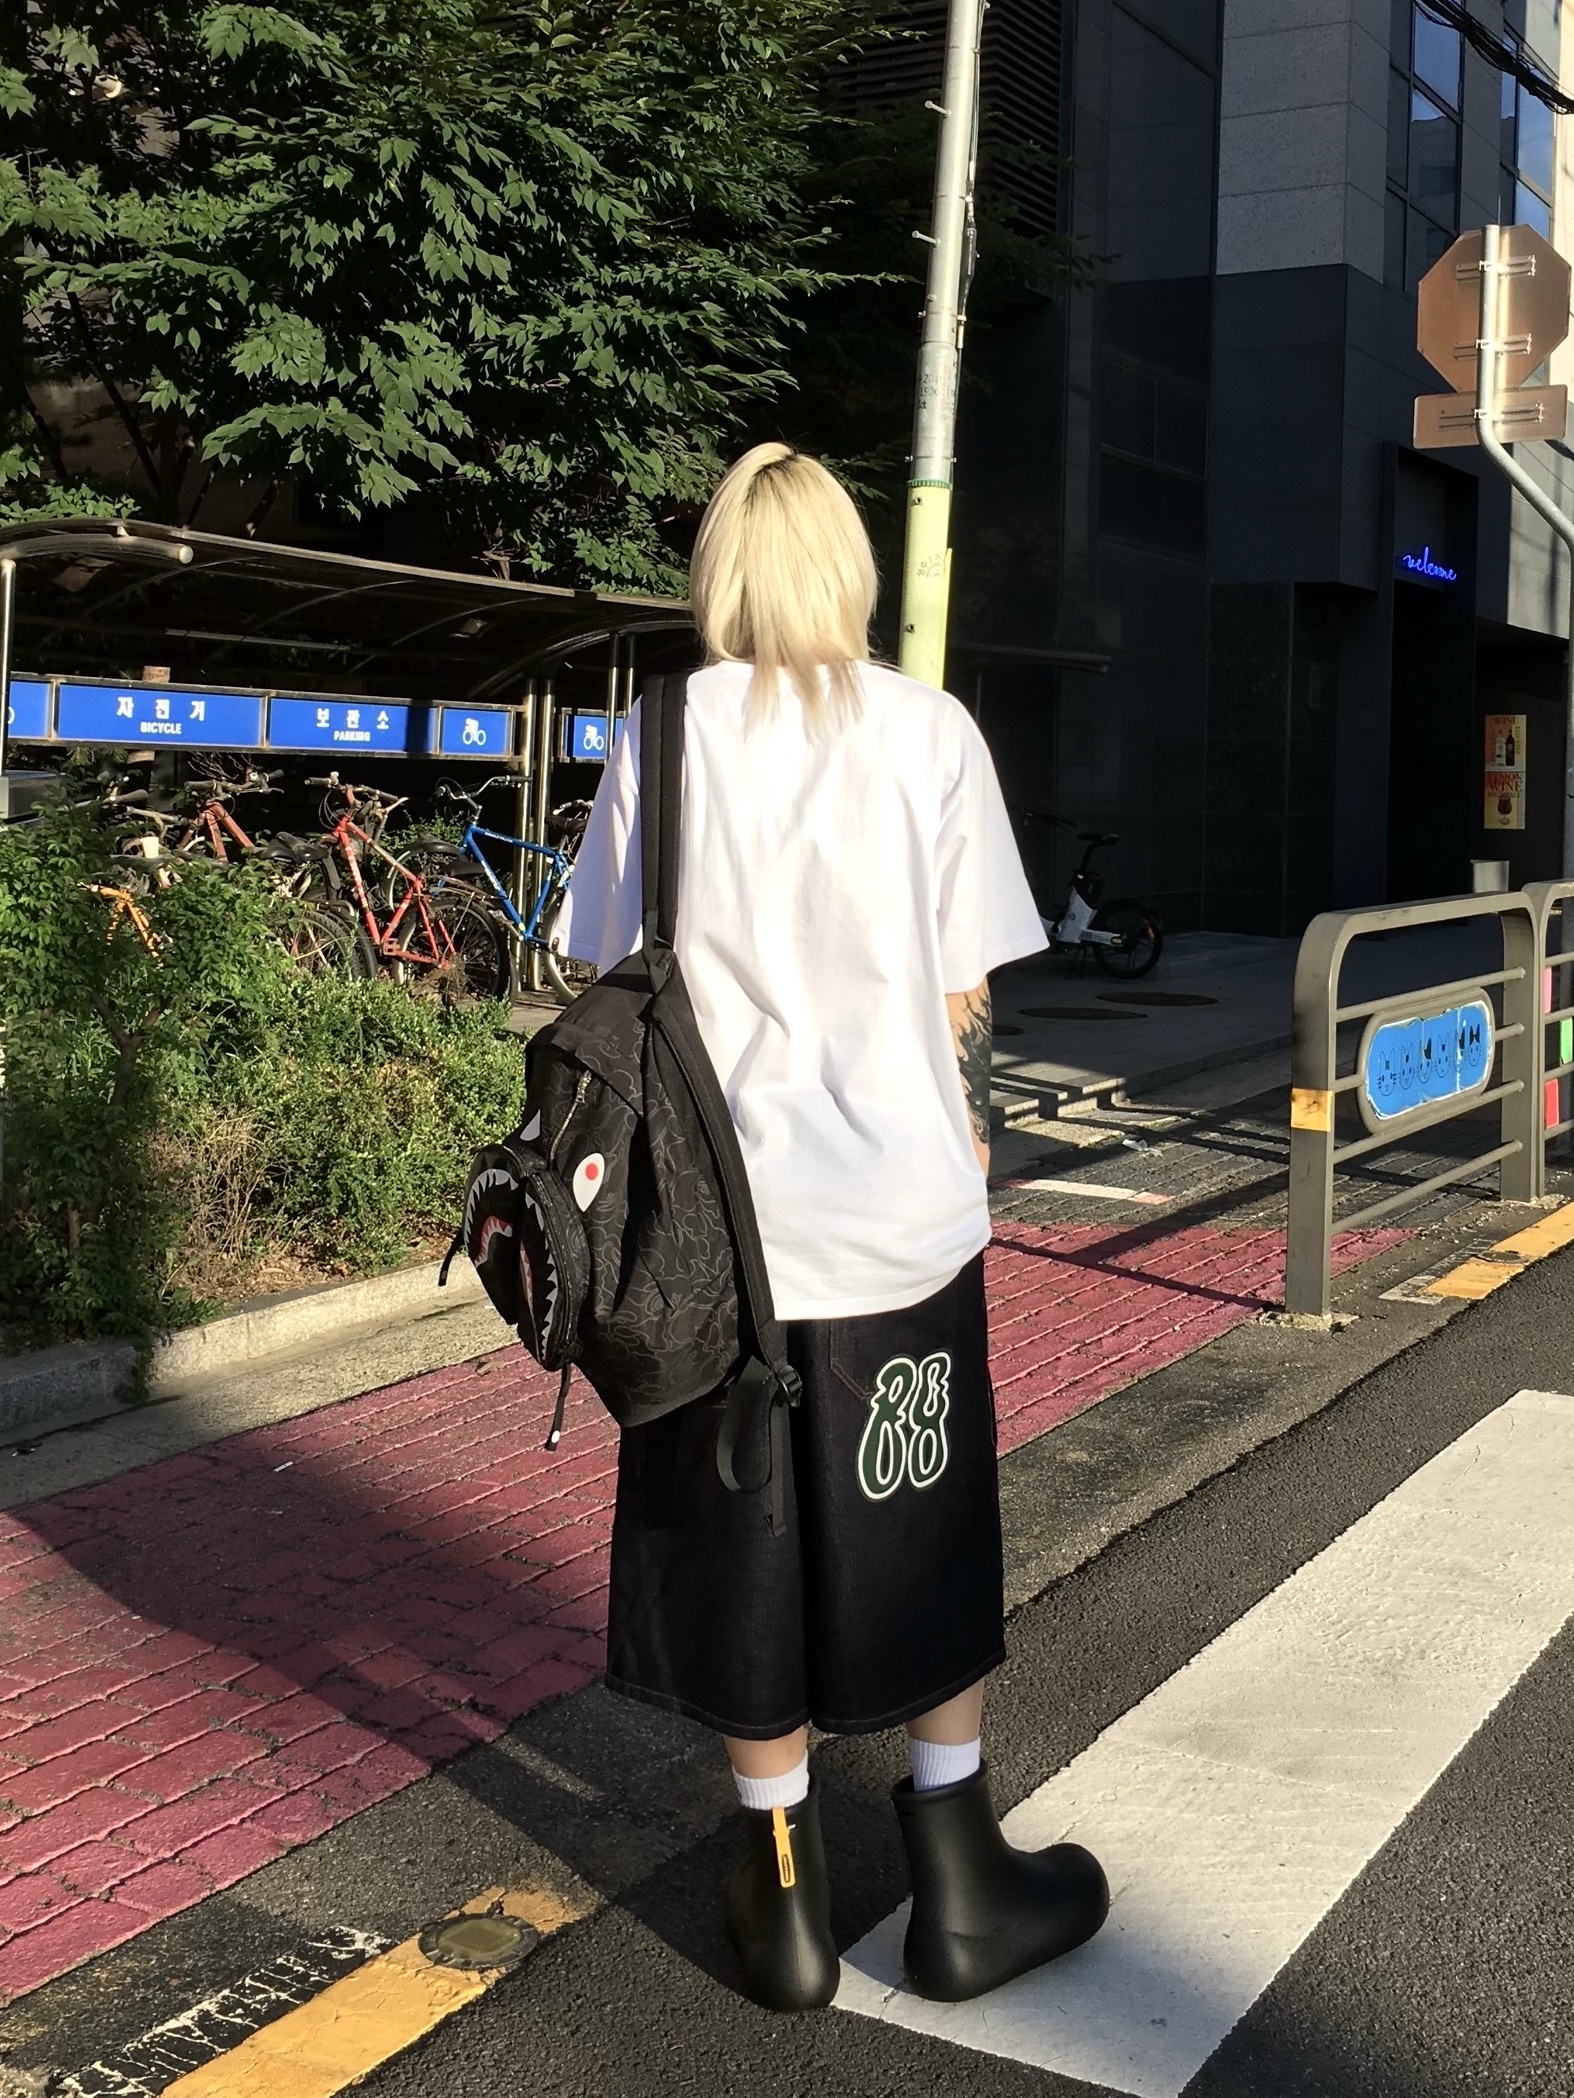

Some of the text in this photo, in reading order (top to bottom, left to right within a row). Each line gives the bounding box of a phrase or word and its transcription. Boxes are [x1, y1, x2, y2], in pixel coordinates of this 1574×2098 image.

[140, 721, 182, 735] BICYCLE
[334, 730, 371, 742] PARKING
[857, 1351, 952, 1500] 88
